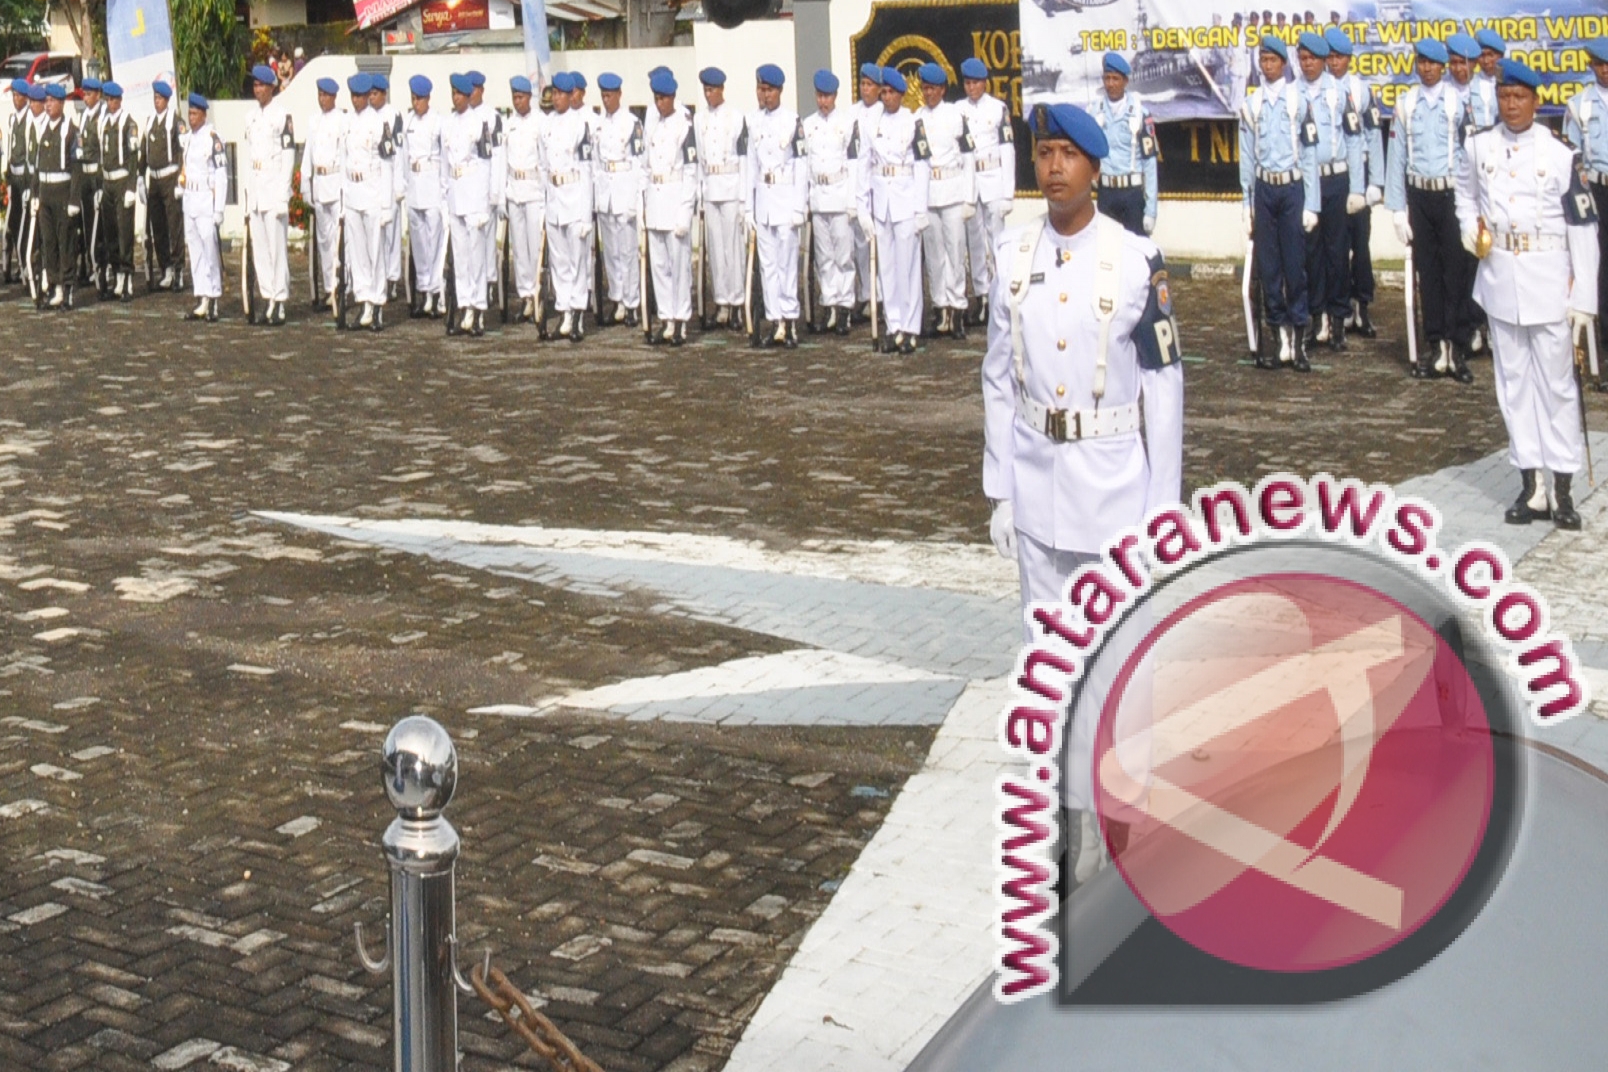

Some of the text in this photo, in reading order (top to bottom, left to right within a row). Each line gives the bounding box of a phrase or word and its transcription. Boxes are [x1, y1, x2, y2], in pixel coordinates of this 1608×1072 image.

[423, 9, 452, 28] Surya
[1079, 29, 1126, 51] TEMA
[1464, 16, 1538, 41] WIRA
[1347, 112, 1359, 131] P
[1306, 122, 1316, 143] P
[917, 140, 927, 156] P
[1143, 137, 1153, 156] P
